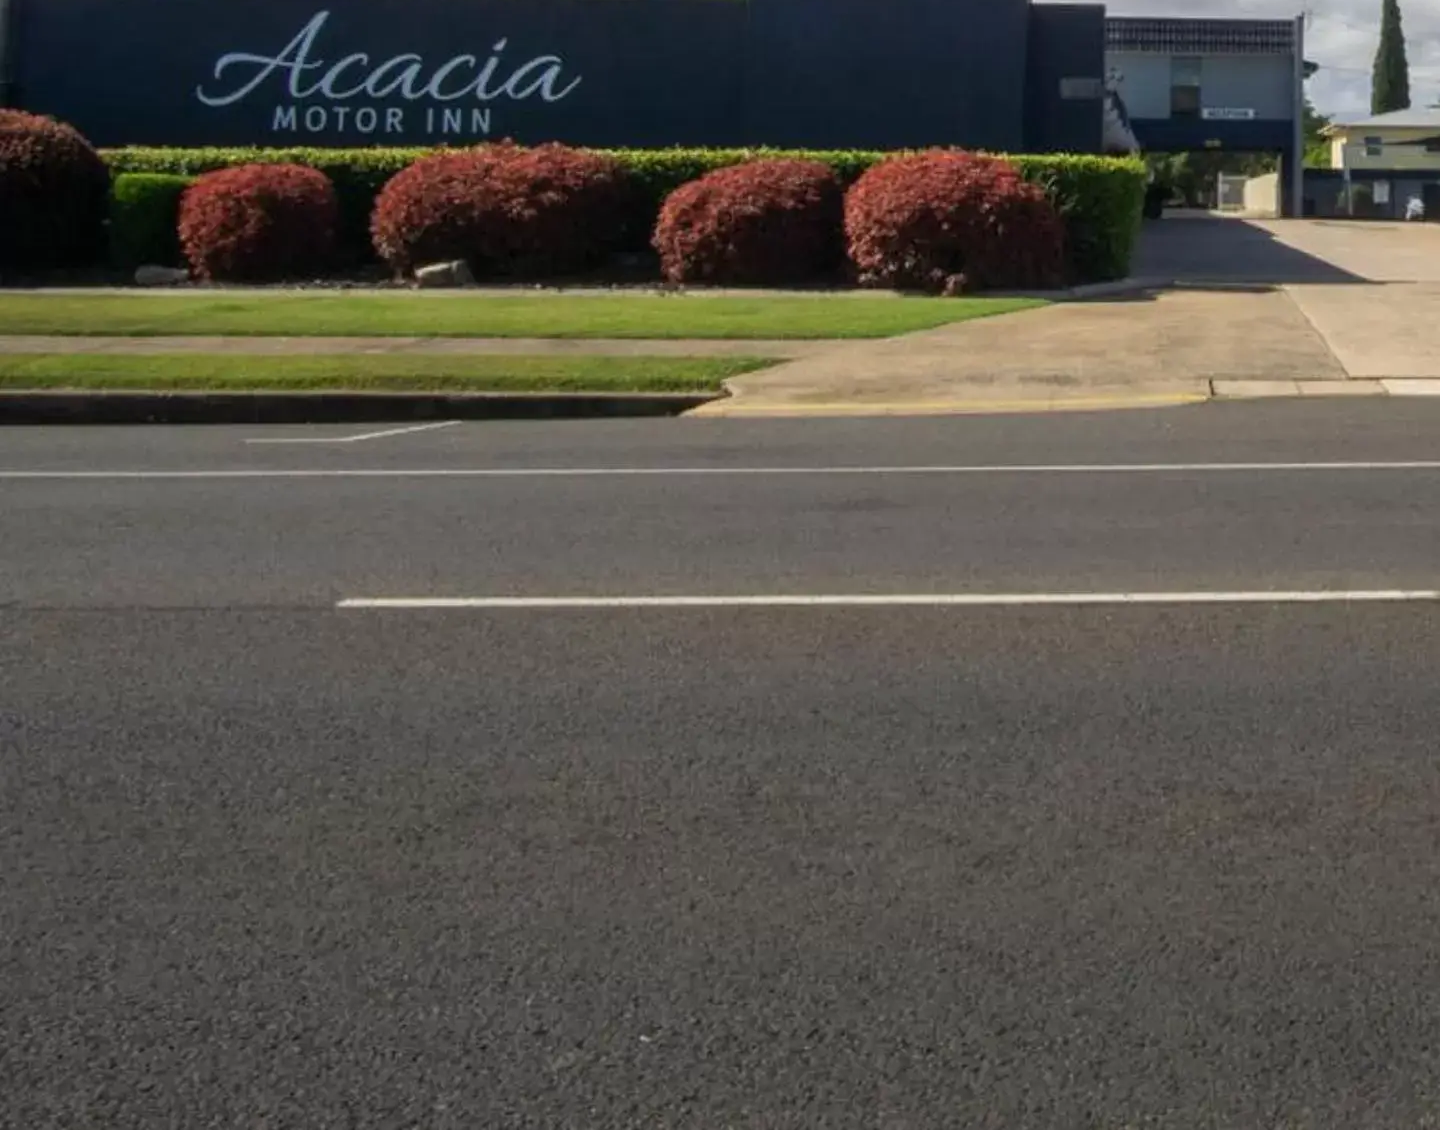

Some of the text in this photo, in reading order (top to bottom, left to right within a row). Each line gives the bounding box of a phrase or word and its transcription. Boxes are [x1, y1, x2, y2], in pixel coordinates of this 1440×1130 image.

[197, 10, 581, 106] Acacia
[273, 105, 491, 133] MOTOR INN
